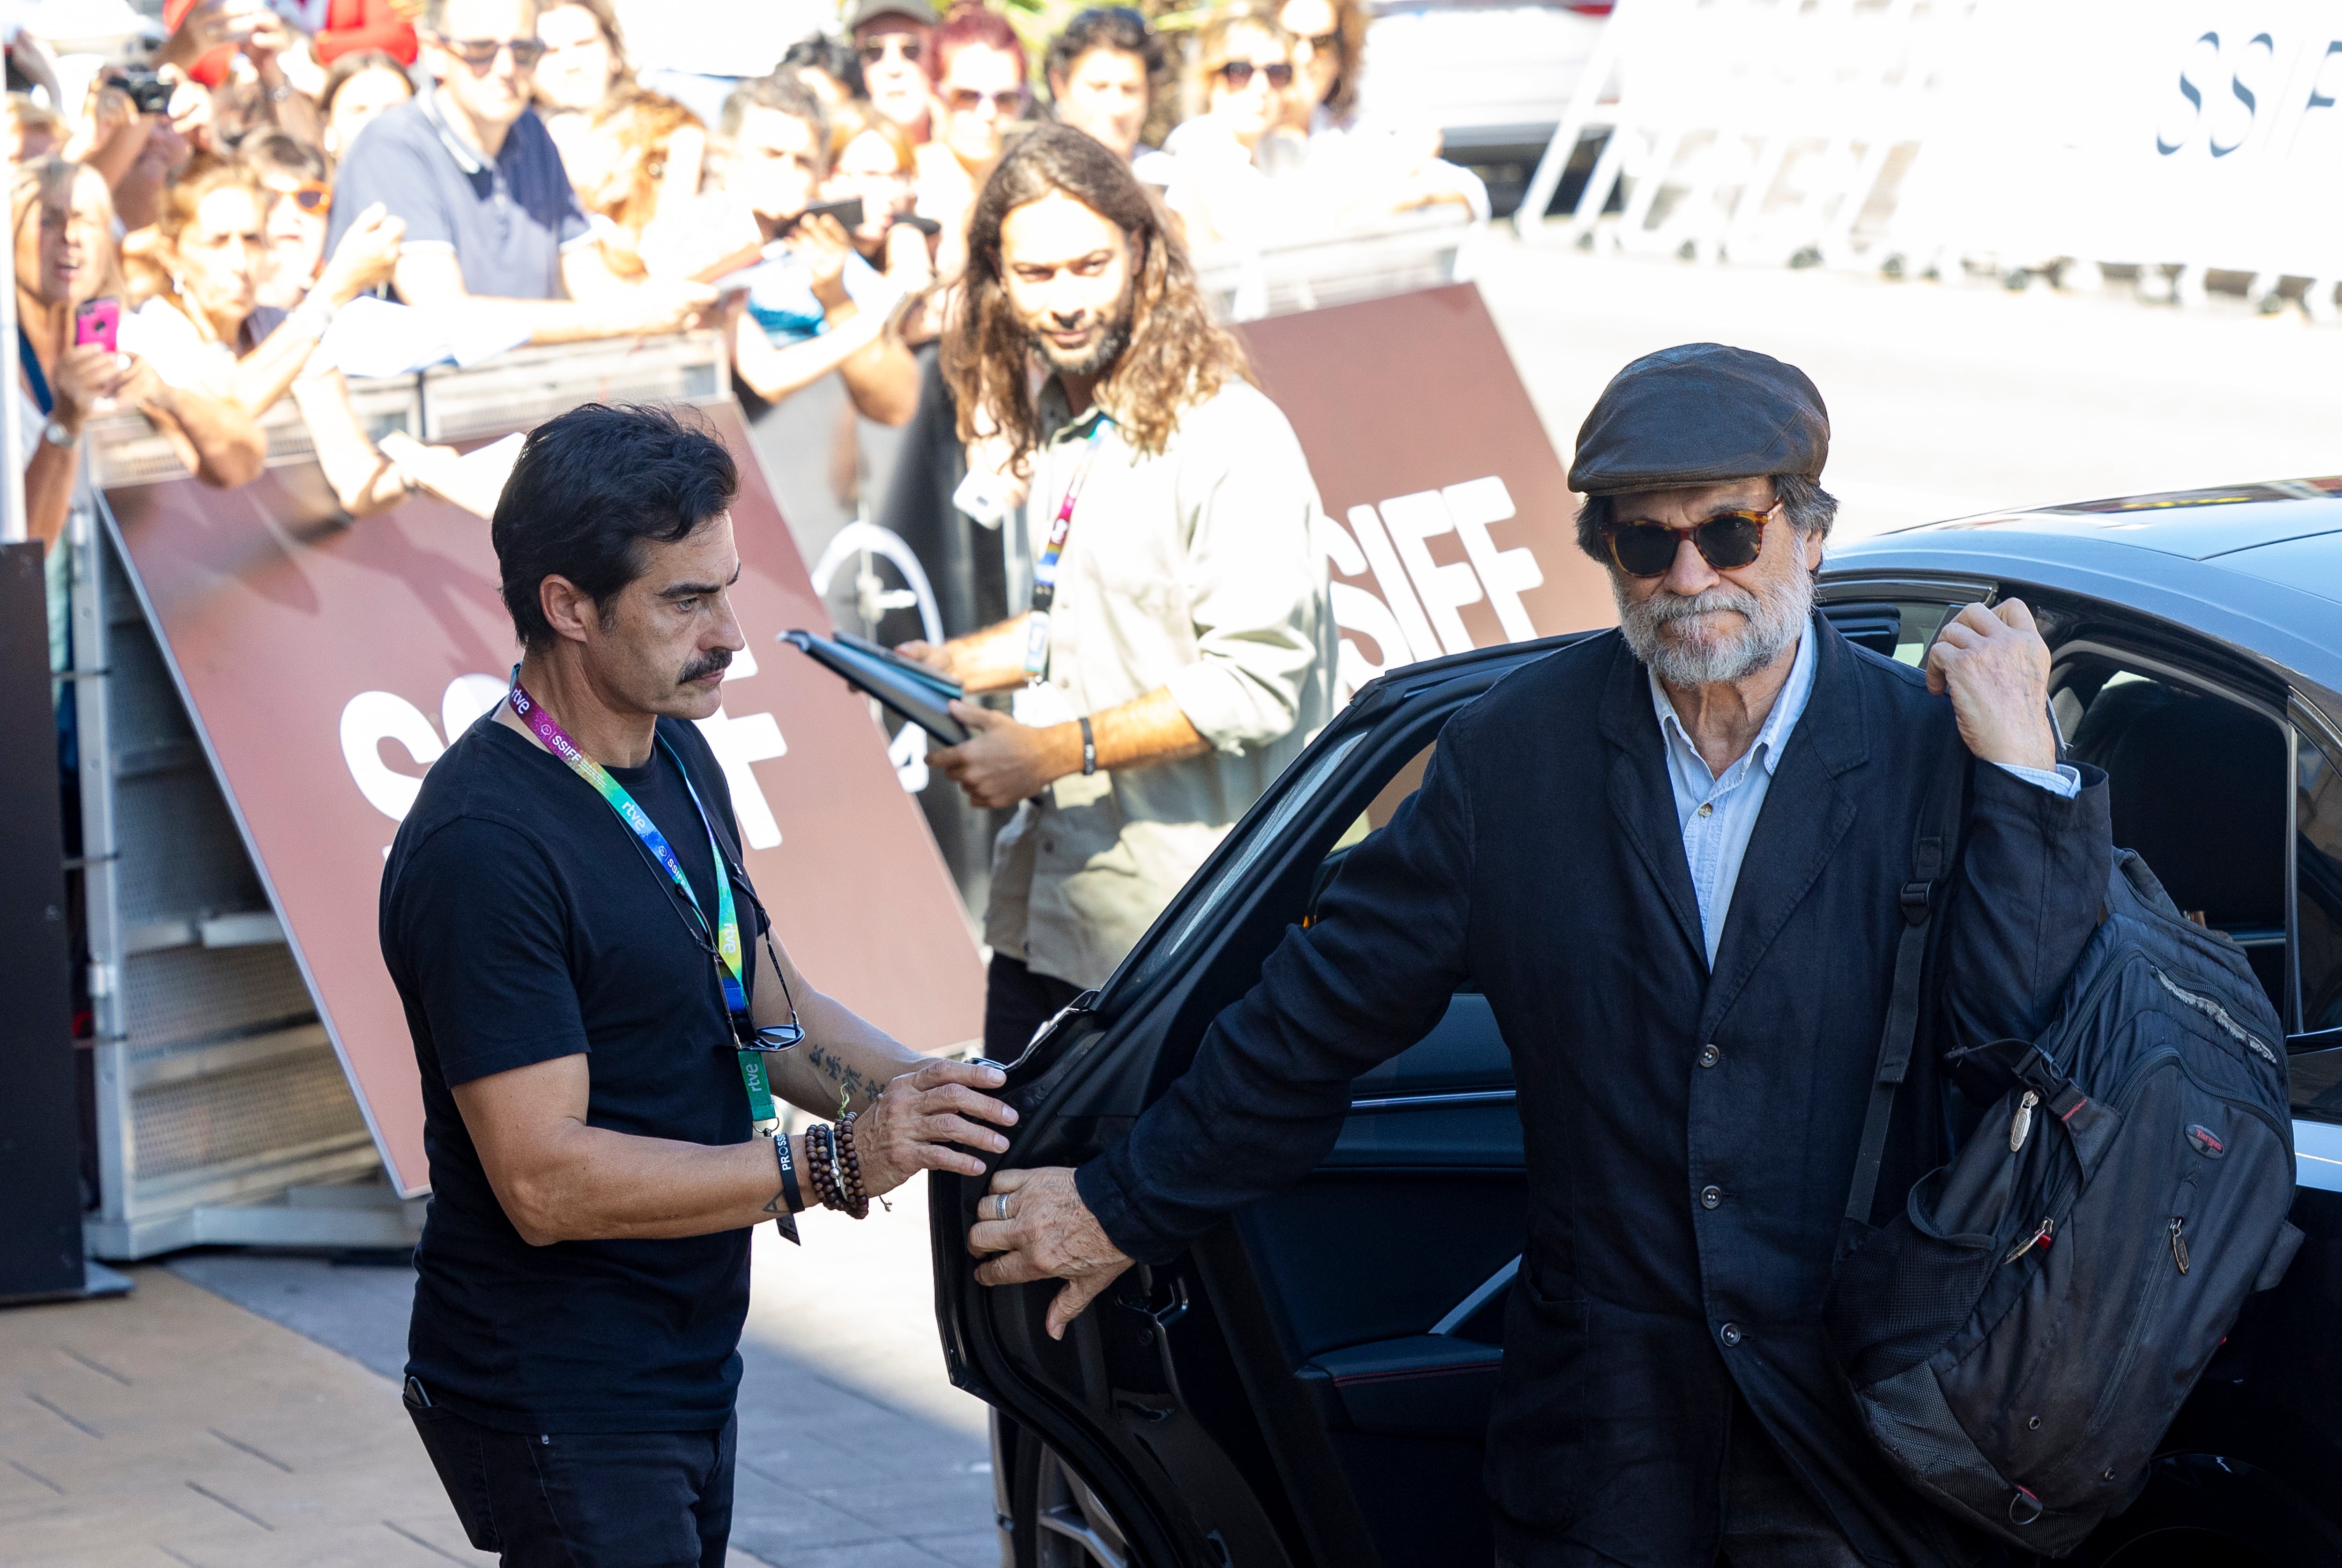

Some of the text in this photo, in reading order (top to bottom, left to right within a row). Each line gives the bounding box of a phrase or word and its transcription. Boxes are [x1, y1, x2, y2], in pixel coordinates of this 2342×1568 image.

[511, 688, 530, 714] rtve
[552, 736, 582, 761] SSIFF
[622, 801, 645, 831] rtve
[722, 923, 736, 954] rtve
[746, 1063, 762, 1092] rtve
